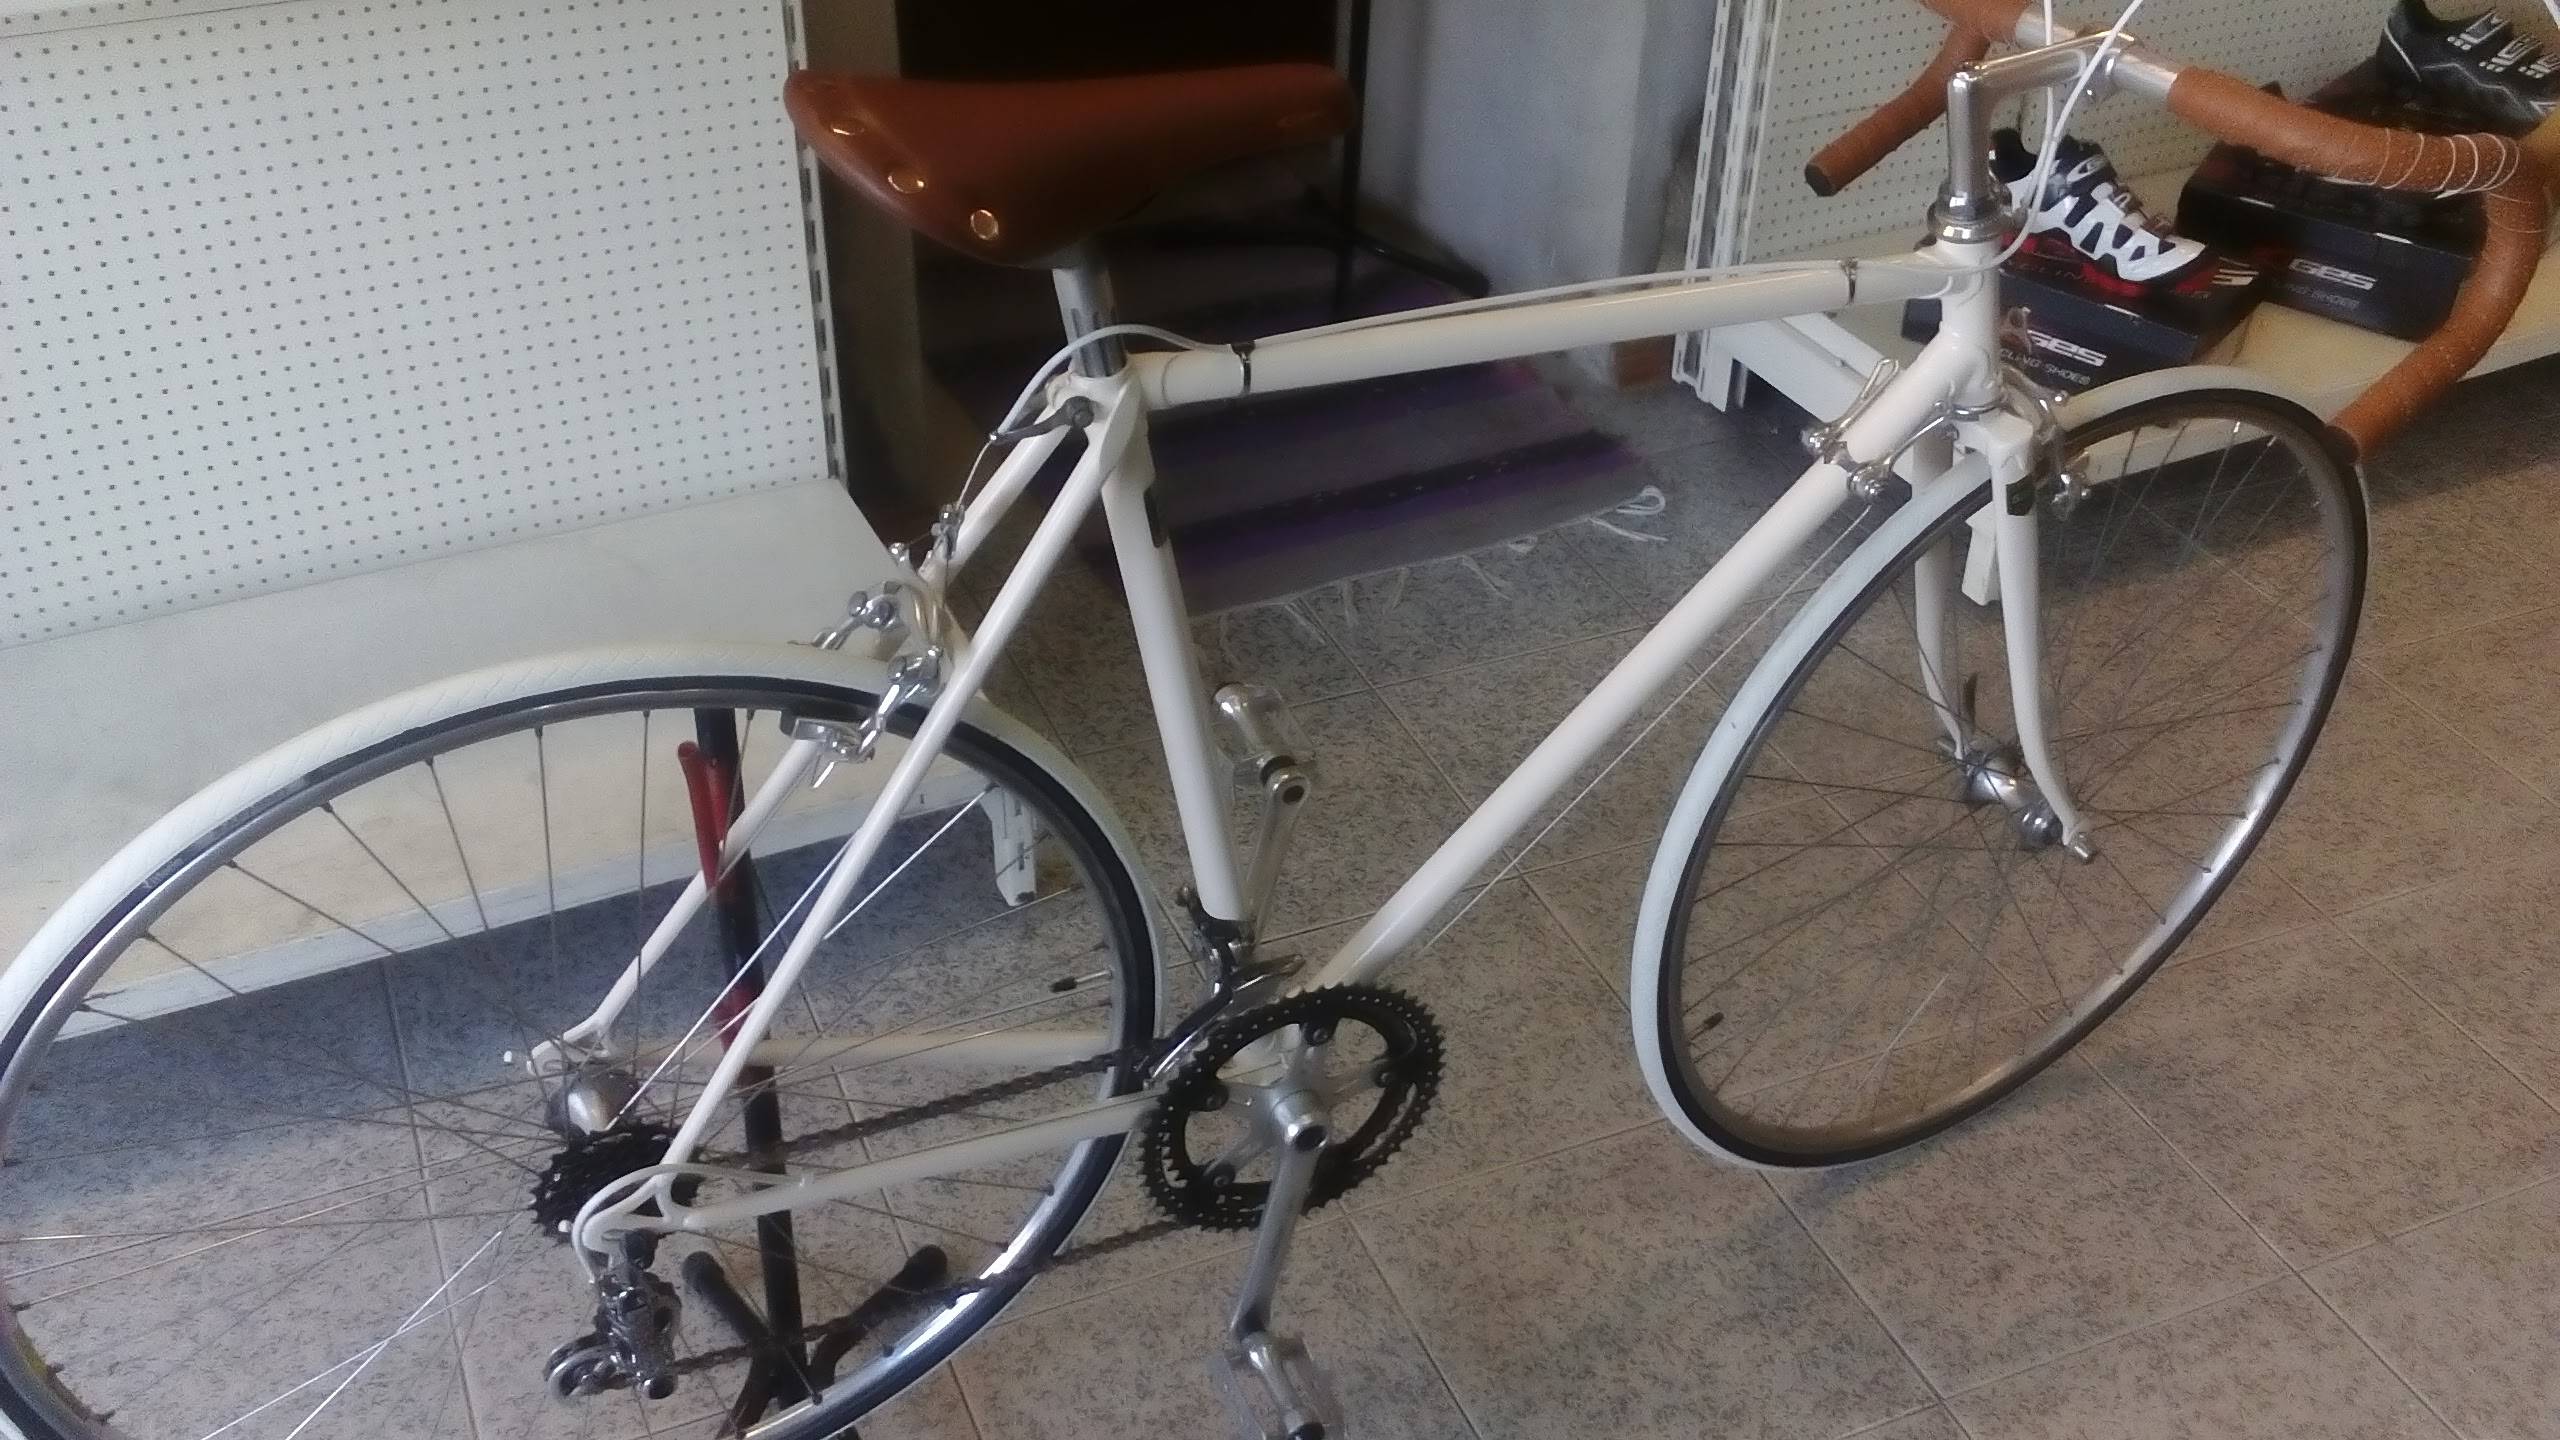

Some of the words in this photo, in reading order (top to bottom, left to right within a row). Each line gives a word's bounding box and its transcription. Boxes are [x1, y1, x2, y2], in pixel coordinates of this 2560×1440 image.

[2288, 257, 2378, 291] GES
[2000, 348, 2042, 368] CLING
[2045, 362, 2091, 386] SHOES
[2027, 329, 2107, 367] GES
